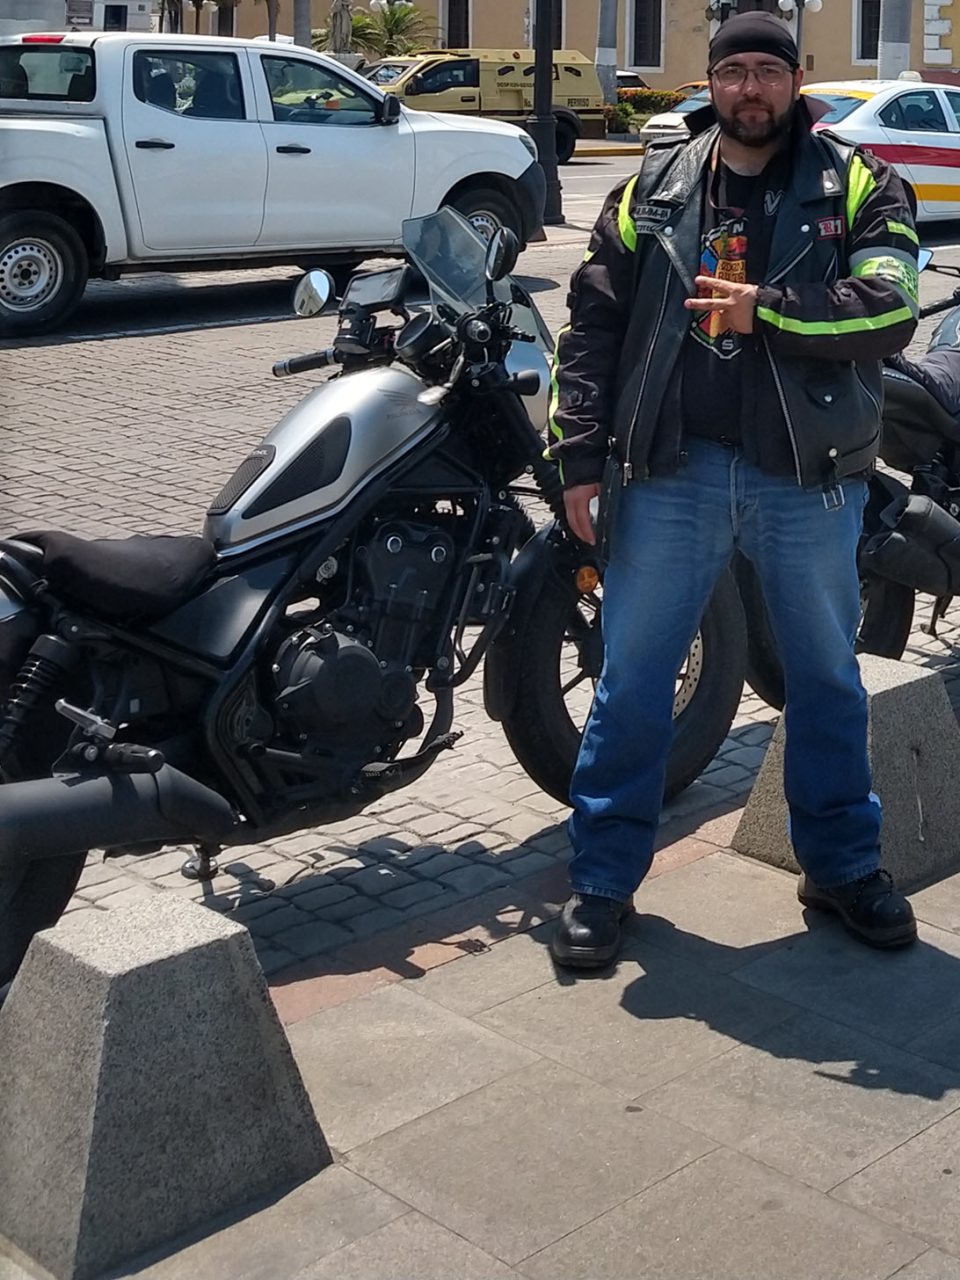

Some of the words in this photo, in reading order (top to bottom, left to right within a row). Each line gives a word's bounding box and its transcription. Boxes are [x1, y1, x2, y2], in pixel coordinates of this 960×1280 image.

[567, 98, 590, 107] PERMISO
[732, 222, 745, 234] N
[721, 339, 735, 351] S
